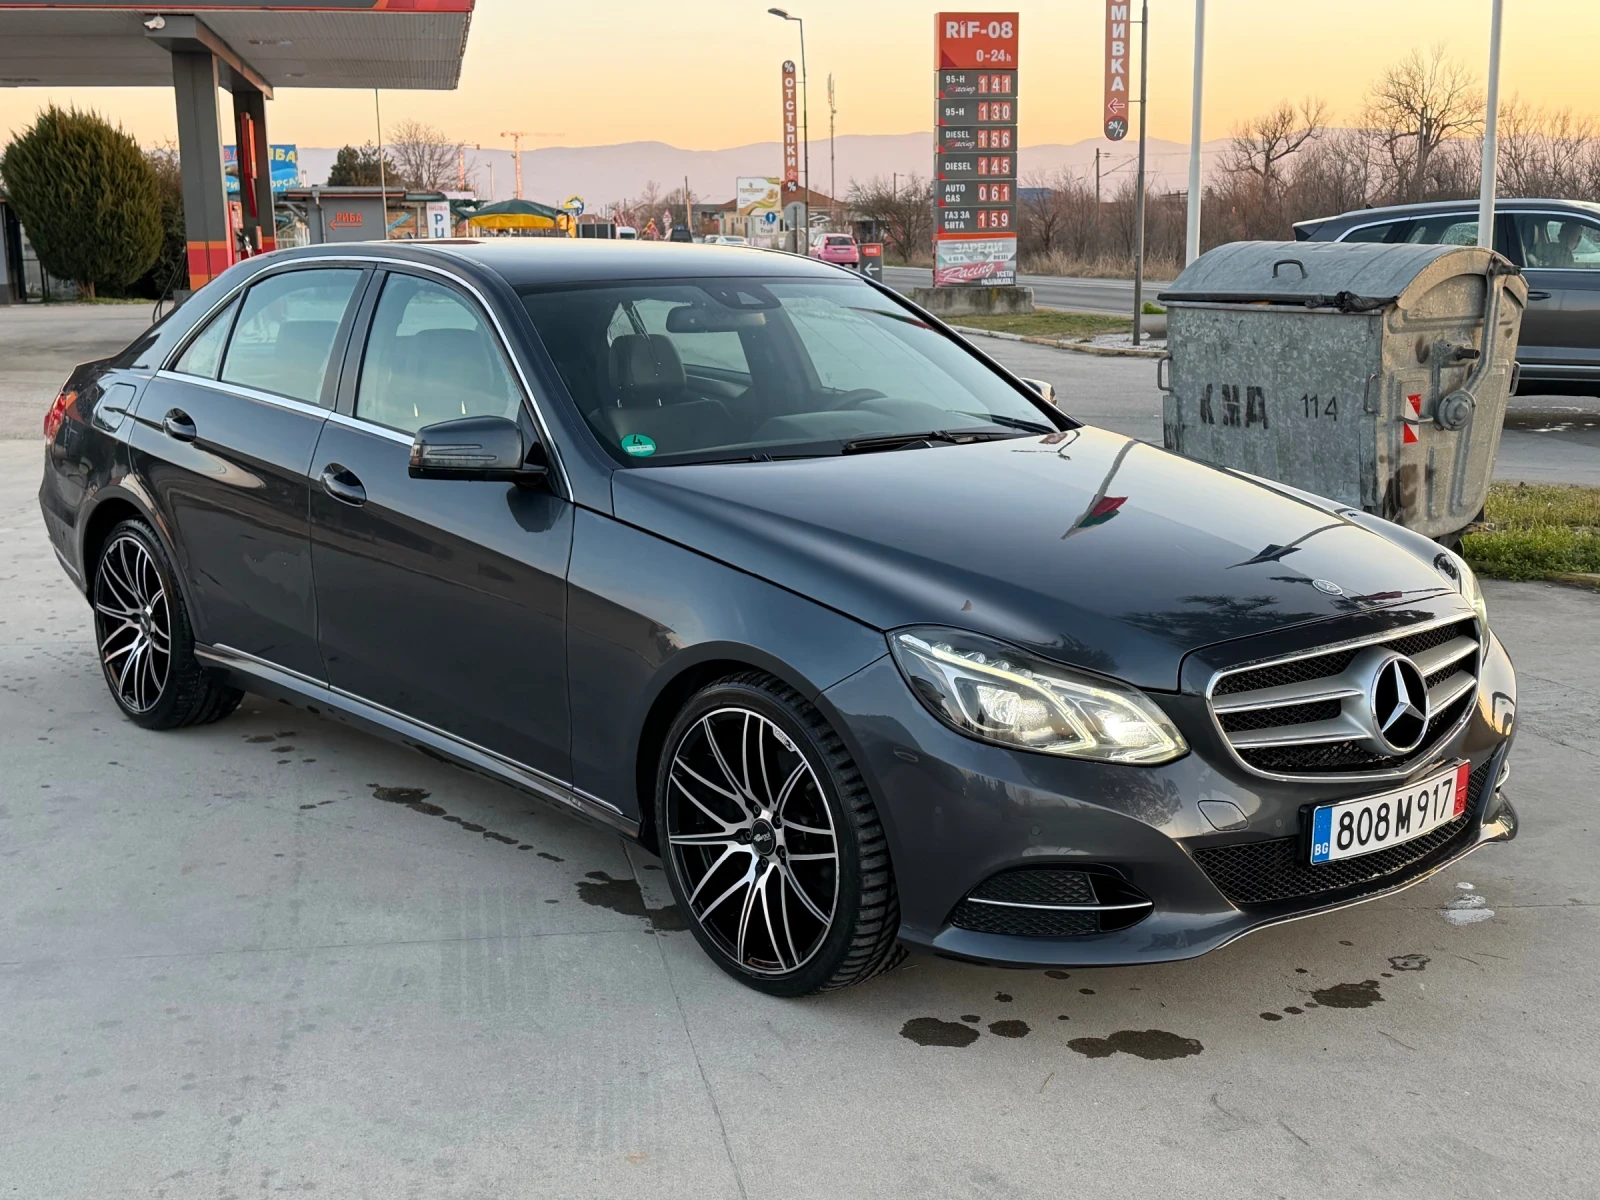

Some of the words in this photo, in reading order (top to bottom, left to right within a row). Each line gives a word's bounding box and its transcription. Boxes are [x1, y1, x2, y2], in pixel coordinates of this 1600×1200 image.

[1110, 0, 1127, 92] МИВКА
[980, 77, 1010, 93] 141
[980, 104, 1011, 120] 130
[784, 77, 797, 167] ОТСТЪПКИ
[945, 130, 970, 139] DIESEL
[980, 132, 1010, 147] 156
[945, 162, 972, 171] DIESEL
[980, 160, 1010, 175] 145
[945, 184, 966, 193] AUTO
[979, 186, 1010, 201] 061
[945, 194, 961, 203] GAS
[336, 212, 363, 223] РИБА
[944, 211, 959, 220] ГАЗ
[959, 211, 971, 220] ЗА
[979, 212, 1009, 227] 159
[954, 242, 1003, 254] ЗАРЕДИ
[943, 263, 995, 283] Racing
[1300, 393, 1338, 421] 114
[632, 434, 643, 446] 4
[1314, 842, 1329, 856] BG
